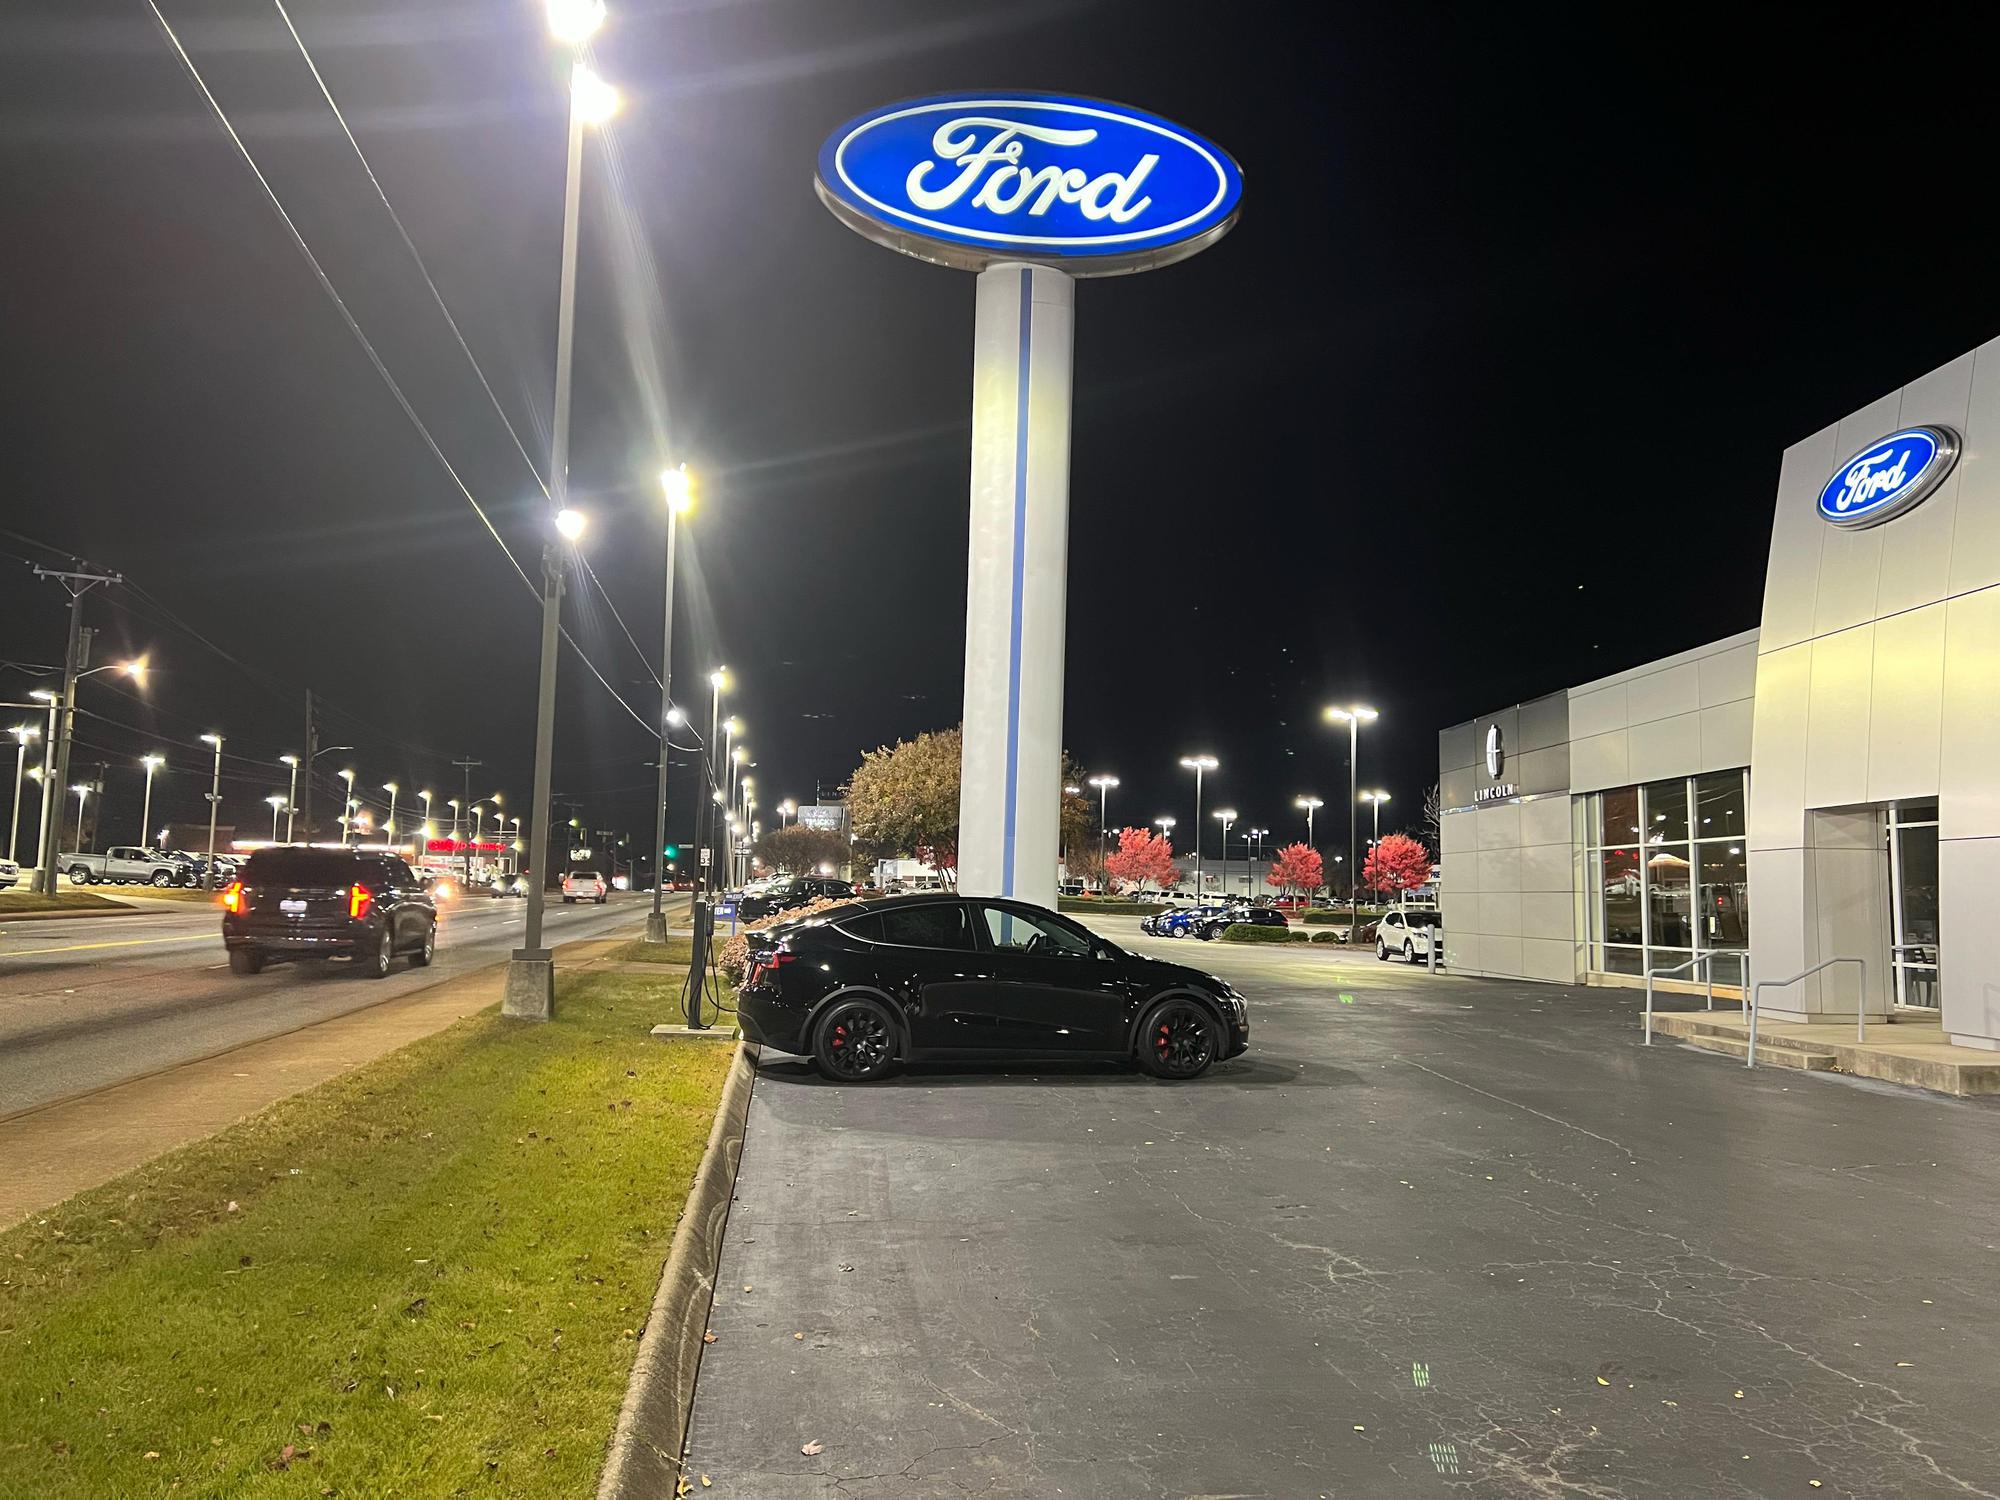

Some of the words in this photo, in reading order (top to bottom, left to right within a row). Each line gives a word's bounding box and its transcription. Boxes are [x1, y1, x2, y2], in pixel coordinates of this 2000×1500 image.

[906, 116, 1160, 223] Ford
[1836, 448, 1911, 512] Ford
[1474, 783, 1514, 802] LINCOLN
